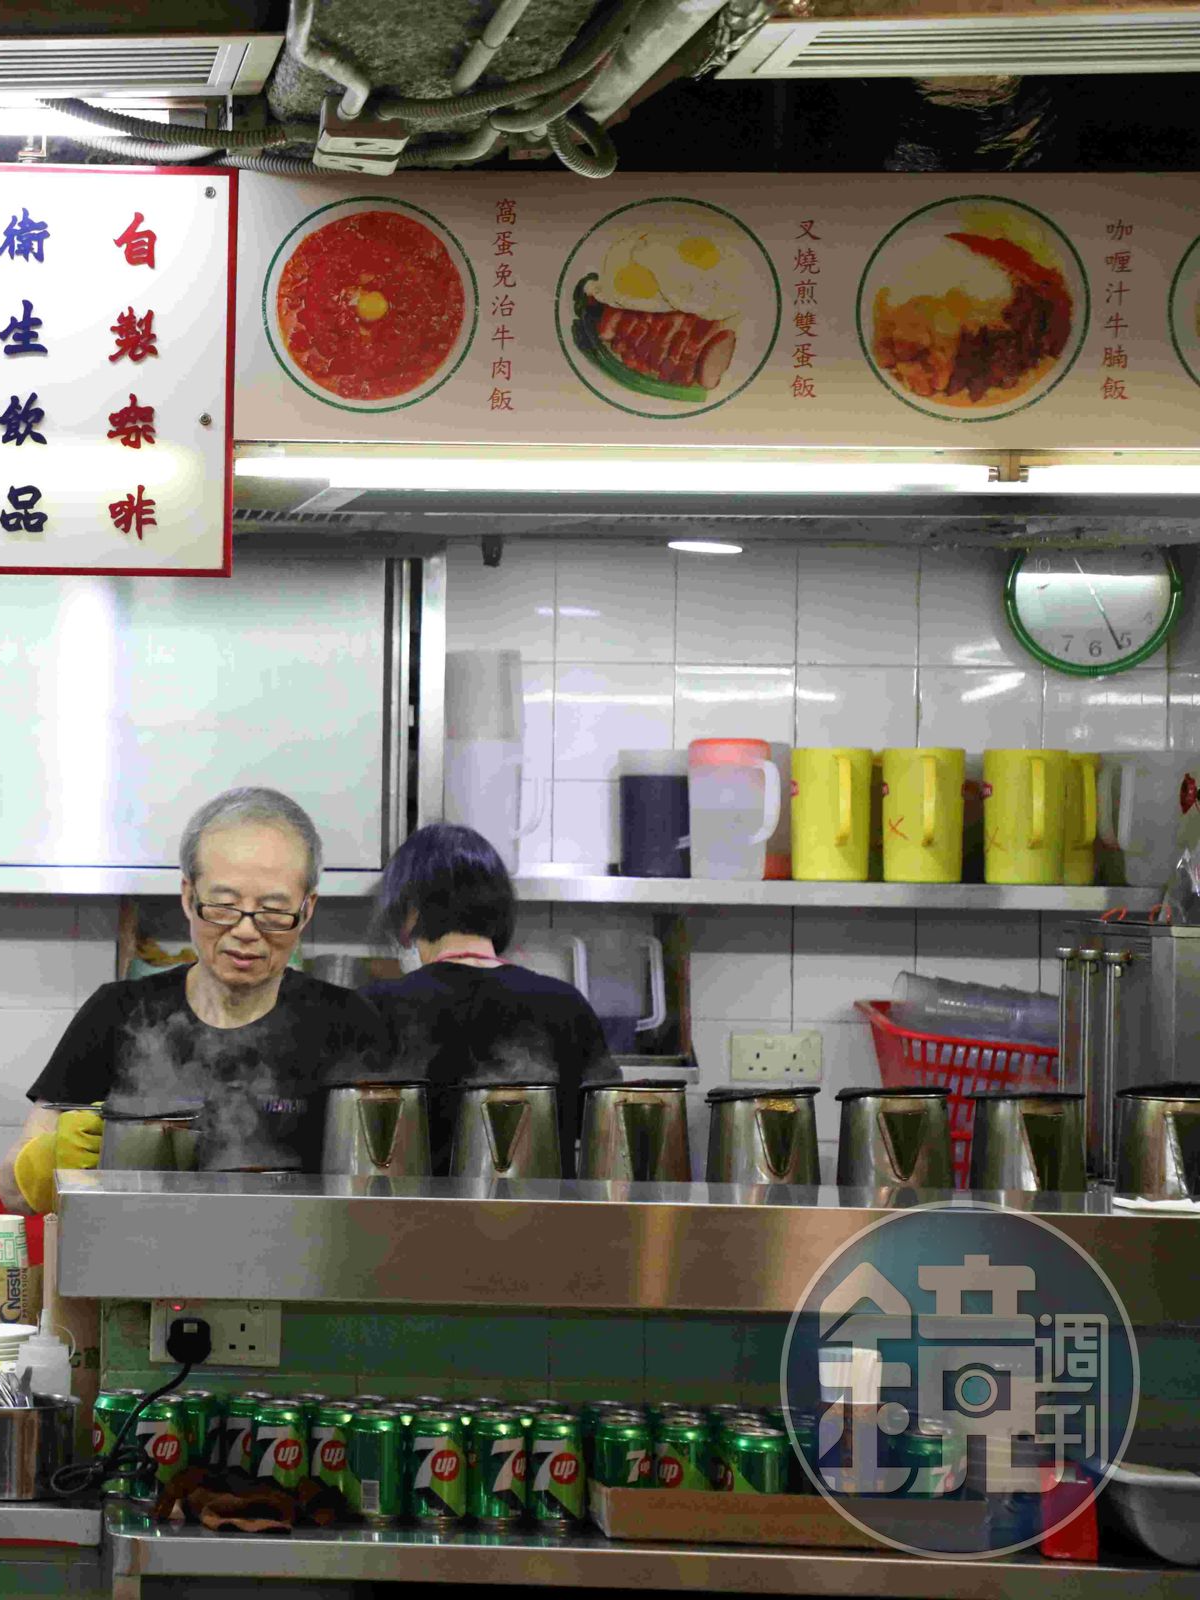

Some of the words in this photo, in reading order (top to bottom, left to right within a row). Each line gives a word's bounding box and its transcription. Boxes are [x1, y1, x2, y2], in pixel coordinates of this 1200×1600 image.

[487, 198, 518, 412] 窩蛋免治牛肉飯
[791, 219, 822, 399] 叉燒煎雙蛋飯
[1100, 218, 1133, 400] 咖喱汁牛腩飯
[1089, 640, 1102, 657] 6
